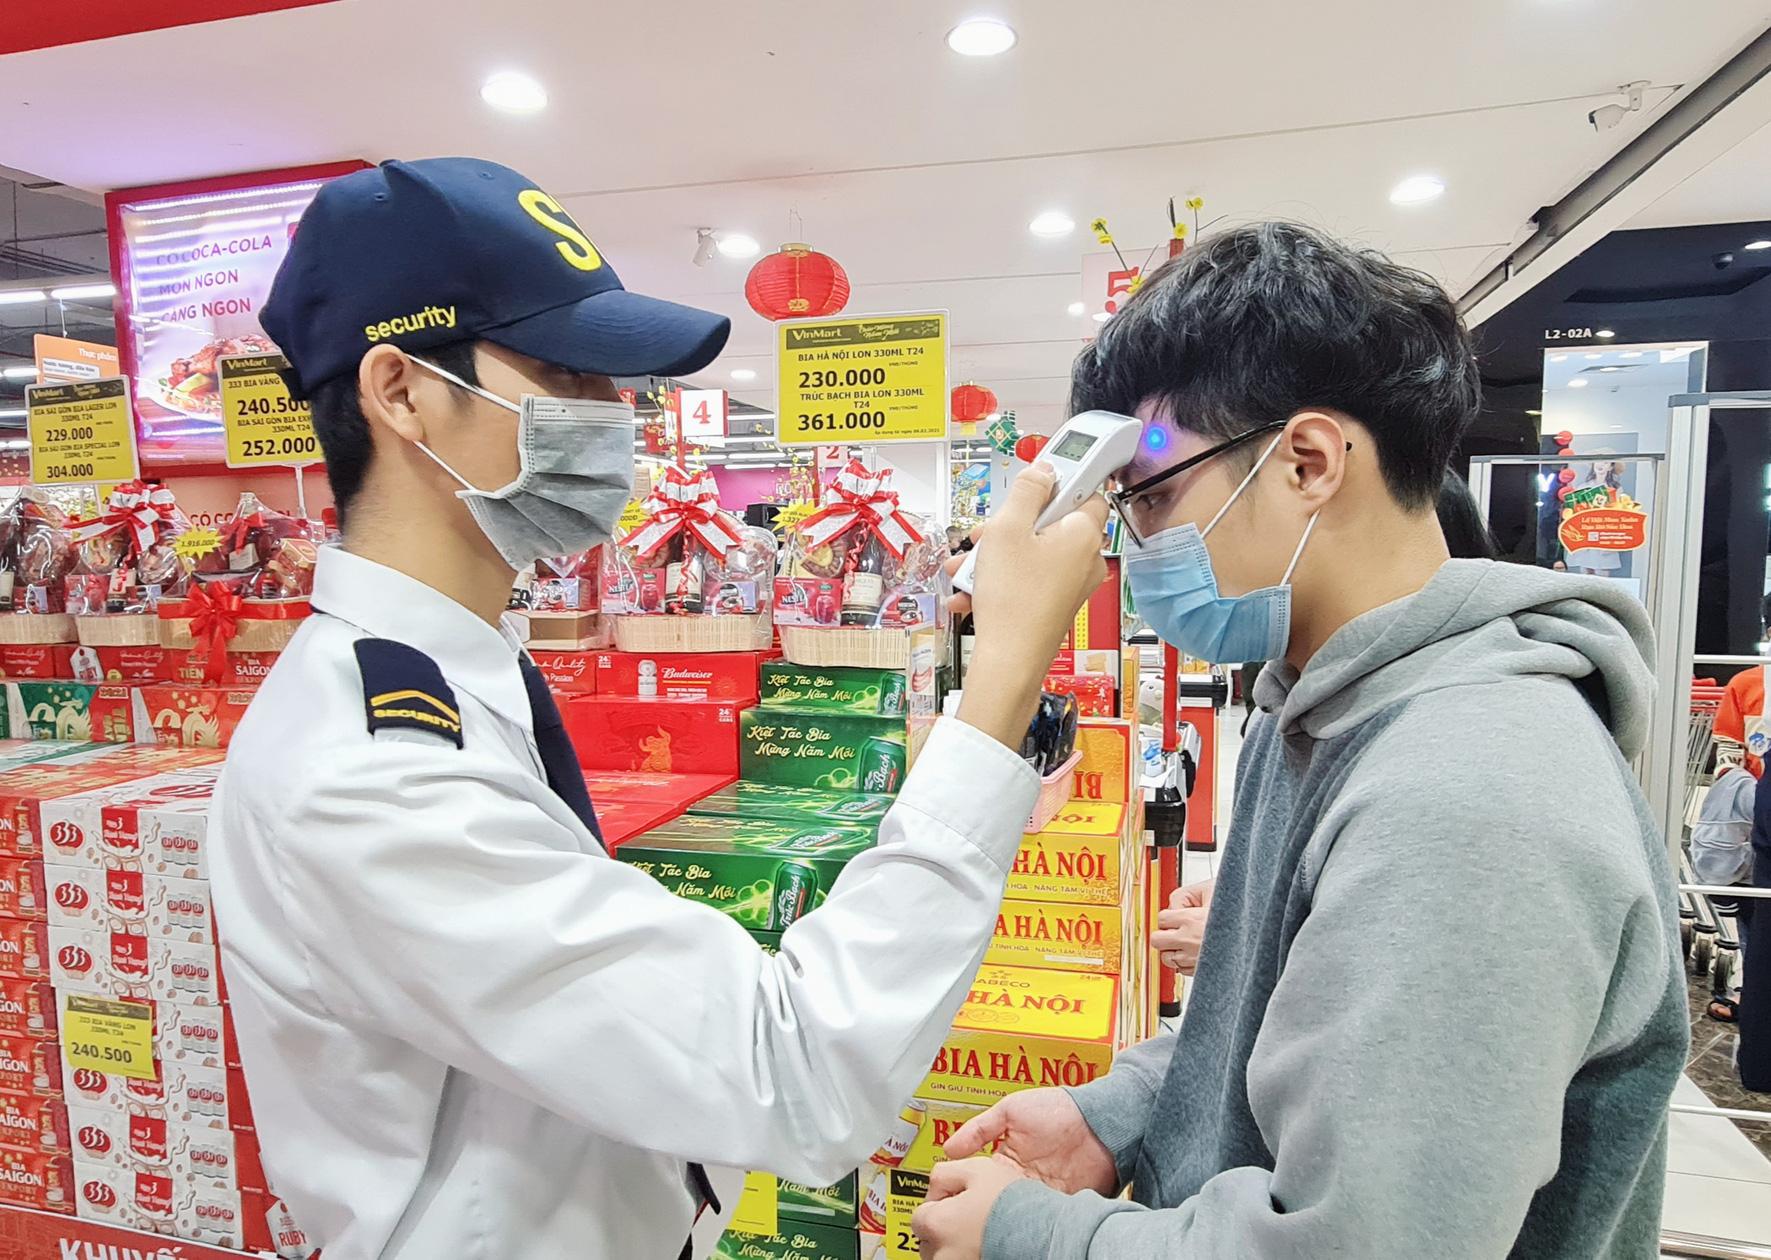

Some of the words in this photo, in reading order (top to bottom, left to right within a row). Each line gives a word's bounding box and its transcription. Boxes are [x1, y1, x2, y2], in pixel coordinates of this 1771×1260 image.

[182, 235, 272, 263] COCA-COLA
[195, 269, 238, 289] NGON
[202, 297, 251, 317] NGON
[364, 306, 456, 342] security
[792, 328, 842, 341] VinMart
[1545, 328, 1592, 339] L2-02A
[798, 353, 814, 362] BIA
[817, 351, 829, 361] HÀ
[832, 349, 849, 362] NỘI
[852, 351, 871, 359] LON
[874, 348, 904, 357] 330ML
[907, 347, 924, 355] T24
[227, 358, 267, 370] VinMart
[228, 380, 242, 389] 333
[244, 379, 258, 387] BIA
[259, 376, 280, 386] VÀNG
[798, 368, 886, 389] 230.000
[800, 390, 824, 401] TRÚC
[827, 390, 851, 402] BẠCH
[854, 390, 870, 399] BIA
[872, 389, 892, 398] LON
[894, 388, 924, 397] 330ML
[692, 400, 711, 424] 4
[854, 400, 870, 409] T24
[252, 417, 264, 426] SÀI
[266, 416, 282, 425] GÒN
[298, 424, 310, 432] T24
[798, 411, 885, 431] 361.000
[46, 427, 93, 442] 229.000
[242, 437, 316, 457] 252.000
[826, 446, 840, 459] 2
[47, 464, 94, 479] 304.000
[661, 667, 713, 679] Budweiser
[767, 674, 791, 687] Kiệt
[793, 675, 811, 686] Tác
[813, 676, 834, 687] Bia
[804, 688, 829, 700] Năm
[747, 725, 776, 741] Kiệt
[780, 726, 803, 741] Tác
[805, 727, 832, 741] Bia
[794, 743, 826, 758] Năm
[54, 819, 78, 845] 333
[1011, 842, 1052, 876] HÀ
[1055, 846, 1108, 885] NỘI
[659, 863, 683, 878] Tác
[685, 864, 712, 880] Bia
[59, 880, 82, 906] 333
[672, 882, 705, 897] Năm
[1013, 908, 1052, 940] HÀ
[1055, 913, 1103, 949] NỘI
[62, 943, 86, 968] 333
[967, 988, 1015, 1008] HÀ
[1021, 993, 1086, 1015] NỘI
[71, 1041, 132, 1064] 240.500
[930, 1046, 985, 1079] BIA
[988, 1045, 1036, 1085] HÀ
[966, 1087, 986, 1095] TINH
[988, 1089, 1008, 1097] HOA
[6, 1106, 20, 1115] BIA
[83, 1126, 105, 1148] 333
[11, 1162, 26, 1171] BIA
[0, 1170, 43, 1187] SAIGON
[87, 1180, 110, 1202] 333
[905, 1199, 915, 1207] HÀ
[278, 1229, 307, 1248] RUBY
[790, 1234, 817, 1249] Bia
